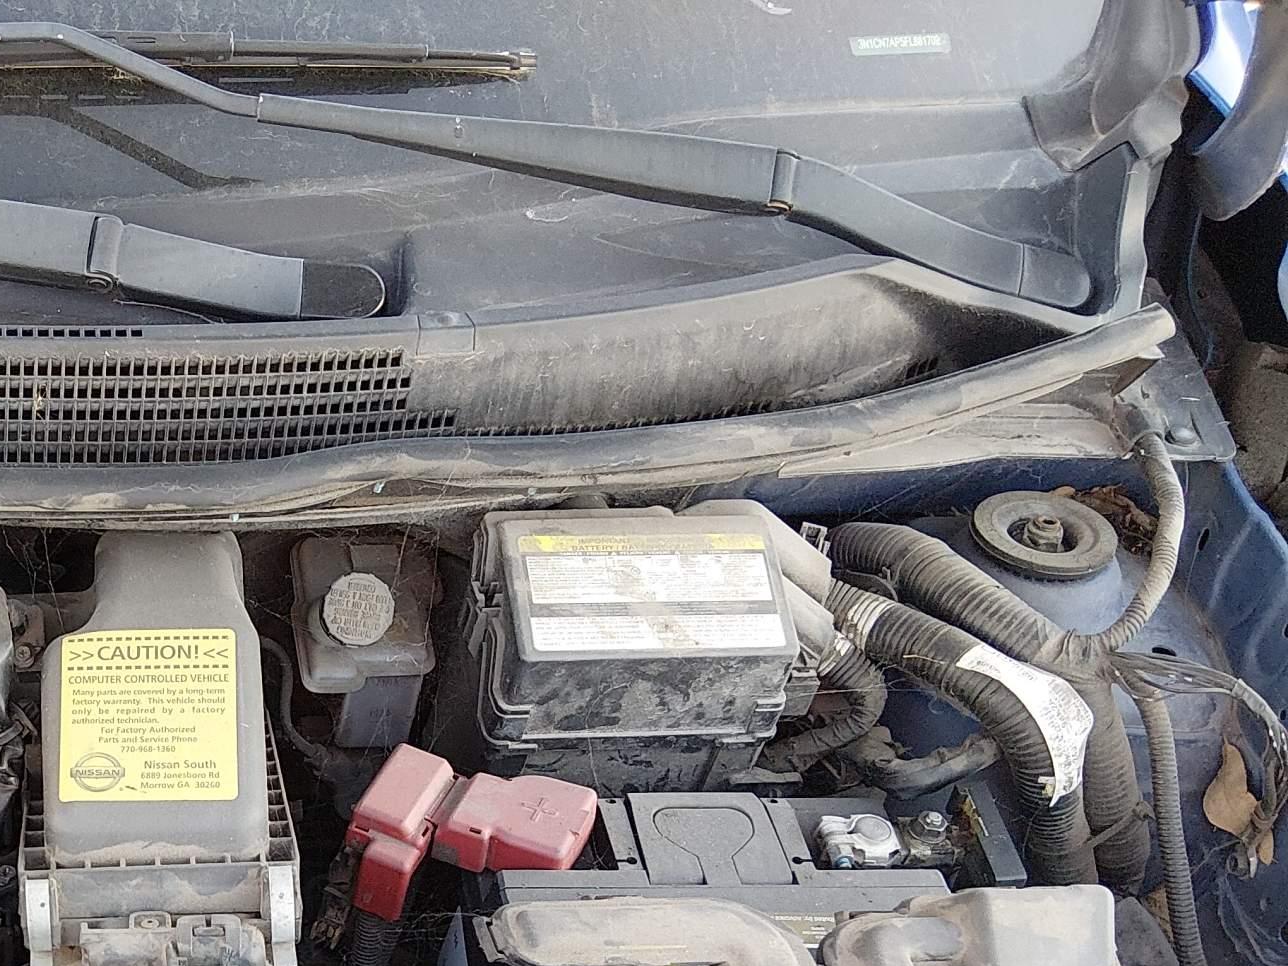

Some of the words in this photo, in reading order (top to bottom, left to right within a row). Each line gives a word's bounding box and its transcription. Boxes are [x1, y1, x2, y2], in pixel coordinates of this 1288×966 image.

[68, 675, 122, 684] COMPUTER
[124, 674, 188, 683] CONTROLLED
[190, 673, 230, 683] VEHICLE
[72, 689, 95, 697] Many
[96, 689, 117, 697] parts
[166, 687, 177, 696] by
[185, 687, 226, 696] long-term
[72, 698, 101, 706] factory
[166, 696, 196, 704] vehicle
[197, 696, 226, 704] should
[71, 708, 92, 716] only
[98, 707, 110, 715] be
[116, 707, 156, 716] repaired
[162, 706, 173, 715] by
[192, 706, 226, 715] factory
[117, 716, 160, 724] technician.
[100, 726, 115, 734] For
[116, 726, 147, 735] Factory
[149, 725, 196, 733] Authorized
[98, 736, 120, 744] Parts
[139, 735, 169, 743] Service
[171, 735, 199, 743] Phone
[144, 760, 180, 769] Nissan
[183, 759, 217, 769] South
[163, 771, 207, 779] Jonesboro
[208, 771, 220, 779] Rd
[140, 781, 175, 789] Morrow
[177, 781, 190, 789] GA
